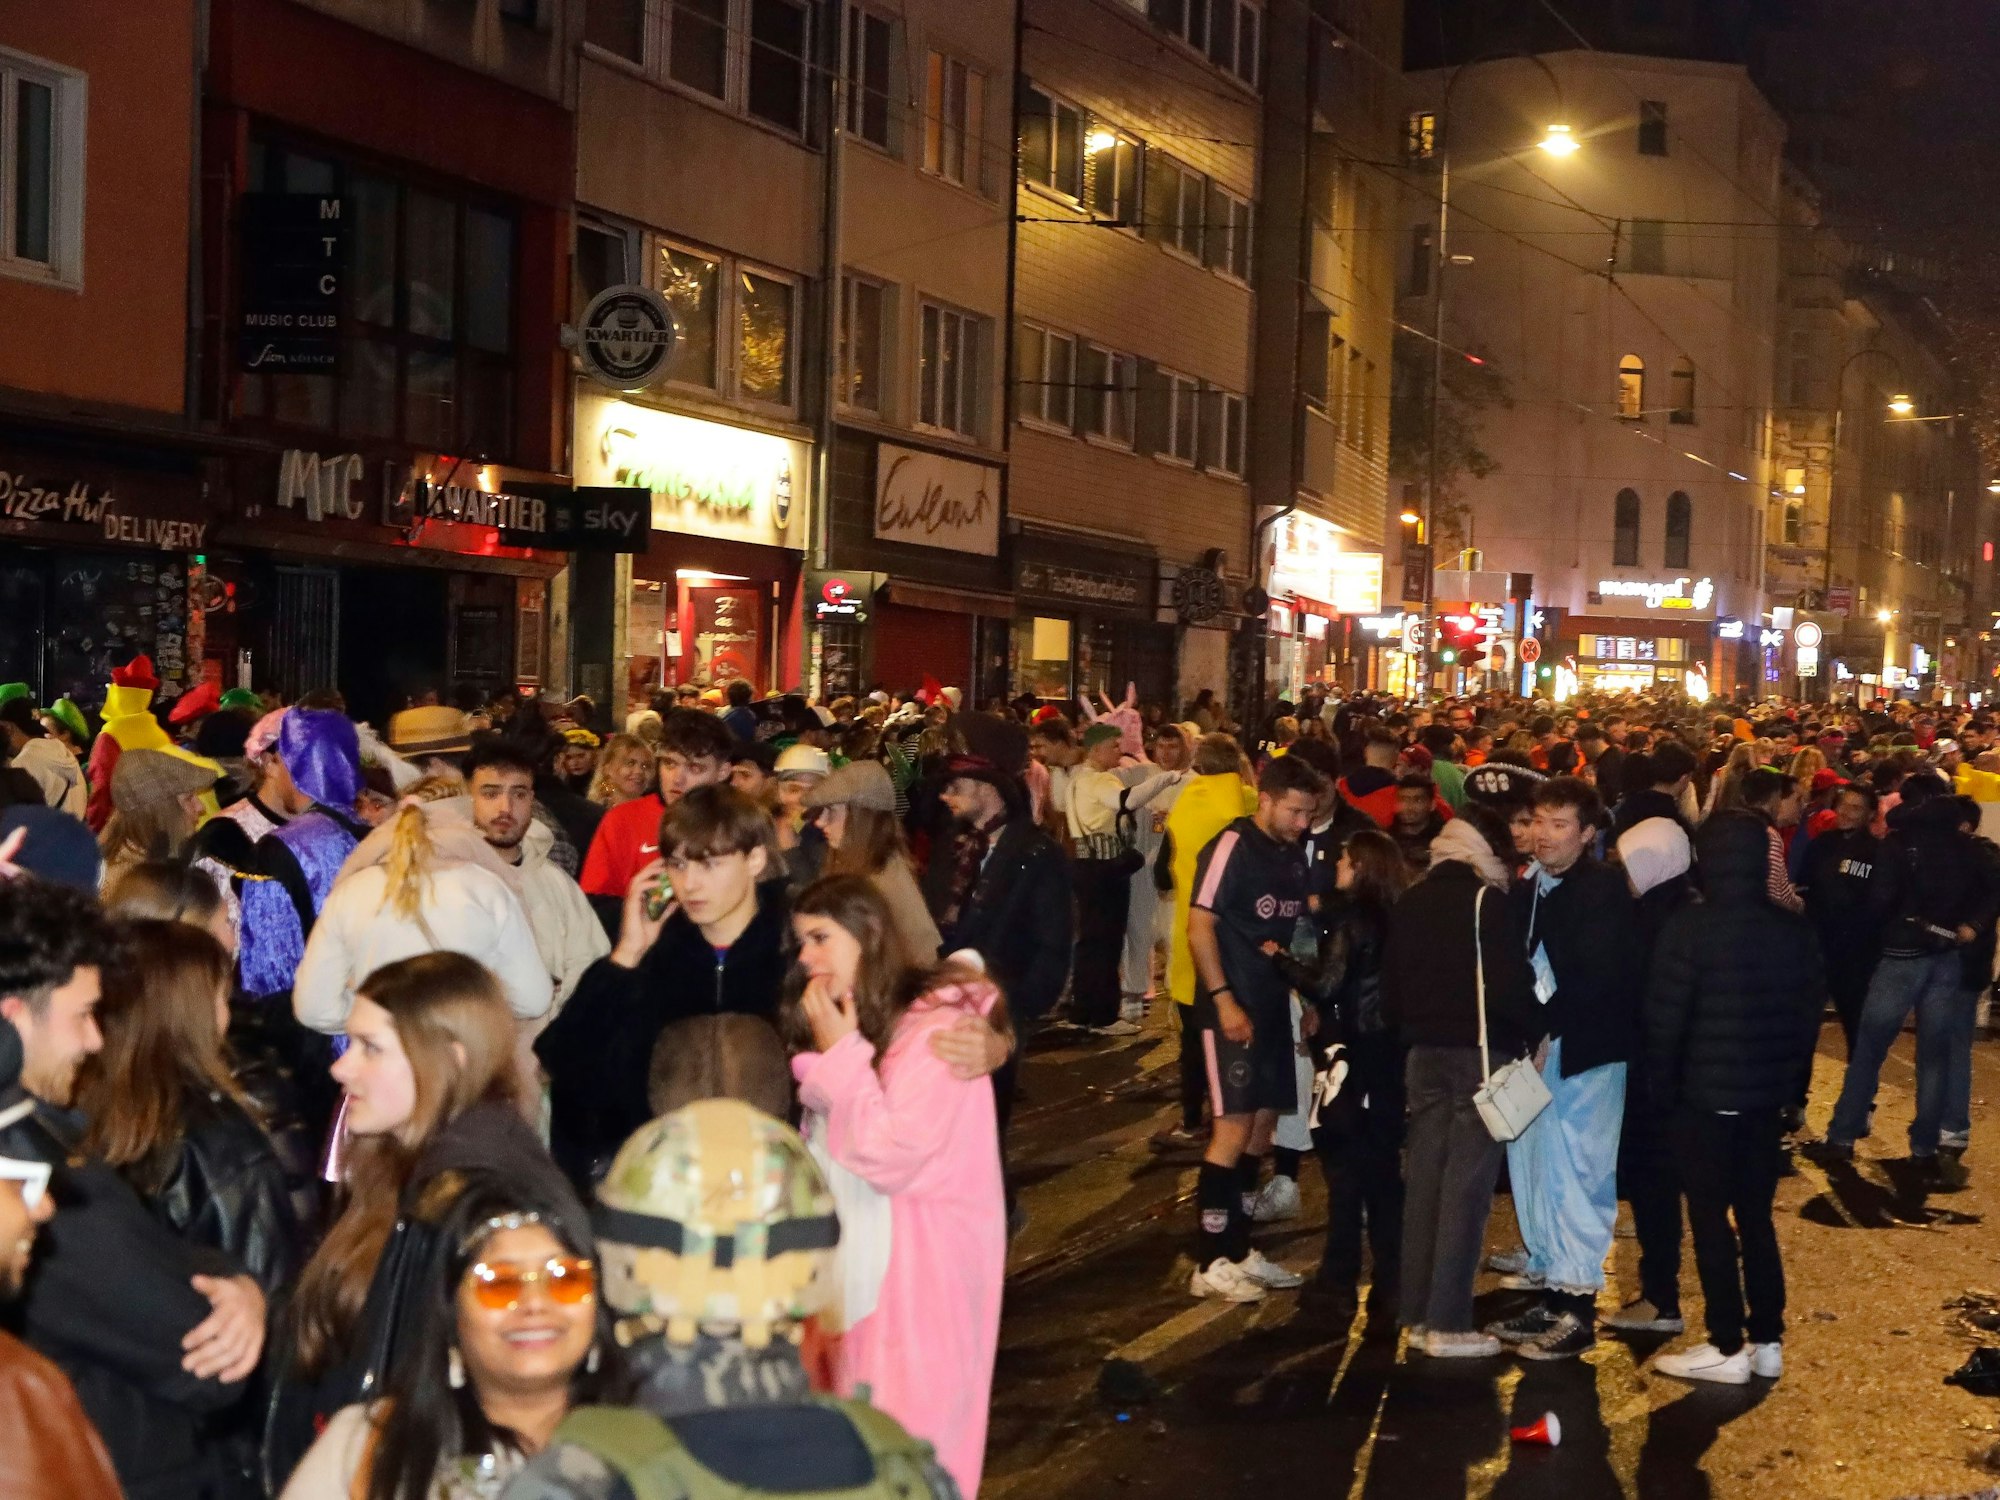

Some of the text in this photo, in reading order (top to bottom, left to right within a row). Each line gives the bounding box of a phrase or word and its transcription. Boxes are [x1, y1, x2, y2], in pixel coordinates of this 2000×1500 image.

[245, 314, 337, 327] MUSIC CLUB
[585, 328, 669, 343] KWARTIER
[0, 471, 116, 522] Pizza Hut
[277, 449, 364, 521] MTC
[427, 484, 546, 533] KWARTIER
[584, 502, 638, 537] sky
[104, 514, 206, 549] DELIVERY
[1599, 578, 1691, 608] mangal
[1844, 859, 1872, 878] SWAT
